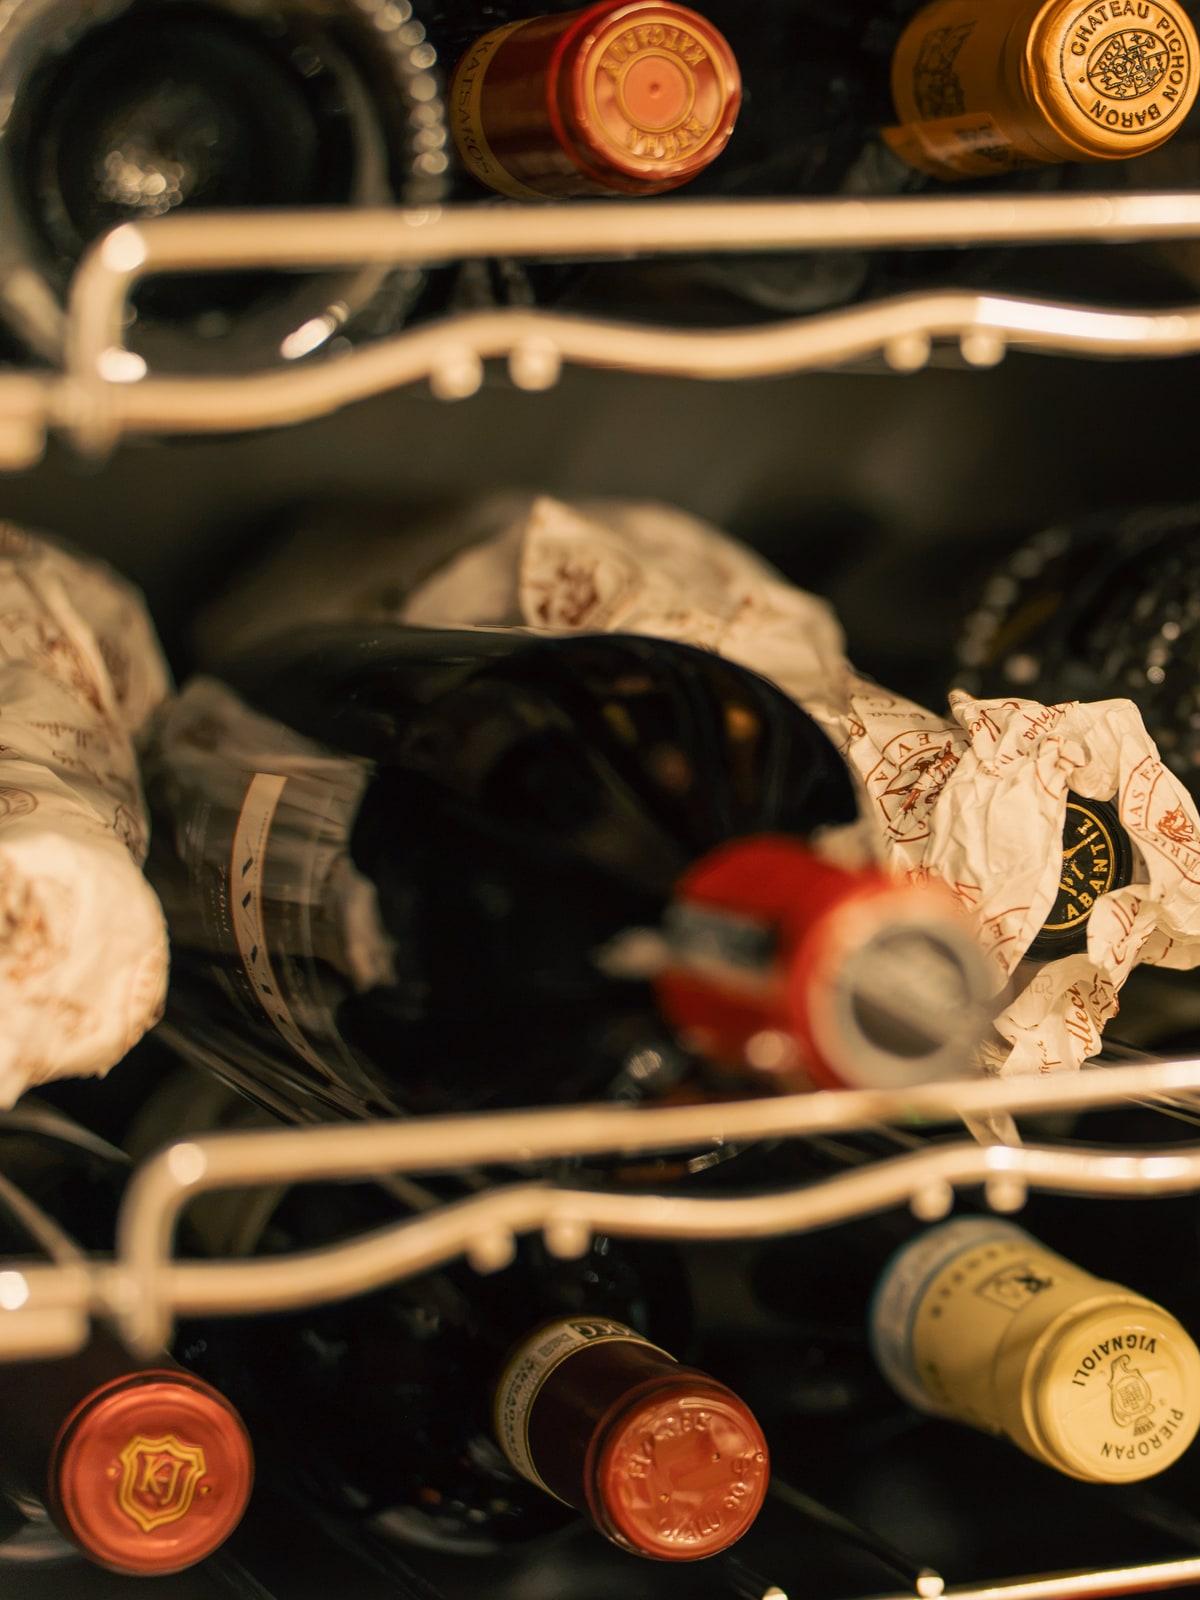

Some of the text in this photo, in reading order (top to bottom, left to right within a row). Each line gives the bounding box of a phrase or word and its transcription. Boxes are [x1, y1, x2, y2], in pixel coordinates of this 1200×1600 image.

[1072, 1, 1185, 128] CHATEAU PICHON BARON
[454, 40, 493, 174] KATSAROS
[1072, 1333, 1157, 1387] VIGNAIOLI
[1100, 1407, 1185, 1461] PIEROPAN
[139, 1455, 186, 1505] KJ
